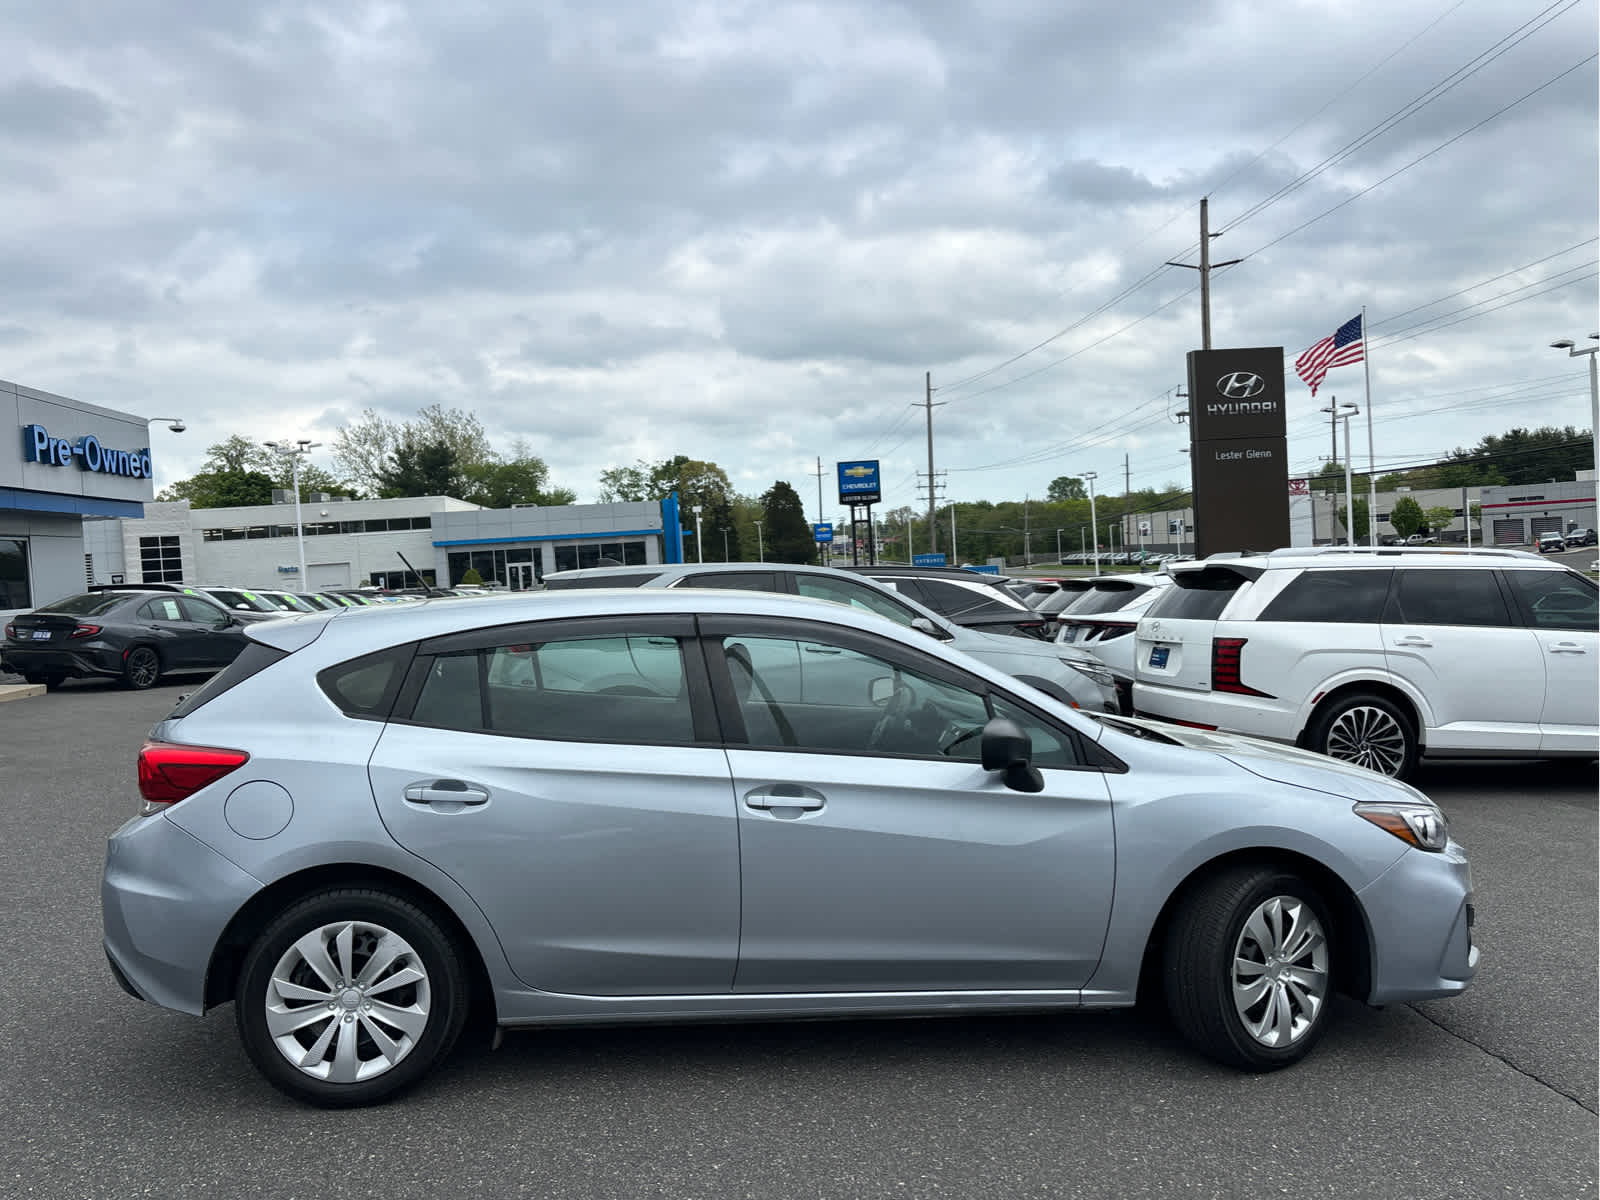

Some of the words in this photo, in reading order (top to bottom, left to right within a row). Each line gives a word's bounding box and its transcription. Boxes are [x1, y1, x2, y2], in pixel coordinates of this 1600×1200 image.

[1207, 401, 1278, 416] HYUNDAI
[25, 424, 152, 479] Pre-Owned
[1215, 451, 1242, 461] Lester
[1246, 449, 1272, 459] Glenn
[842, 482, 877, 490] CHEVROLET
